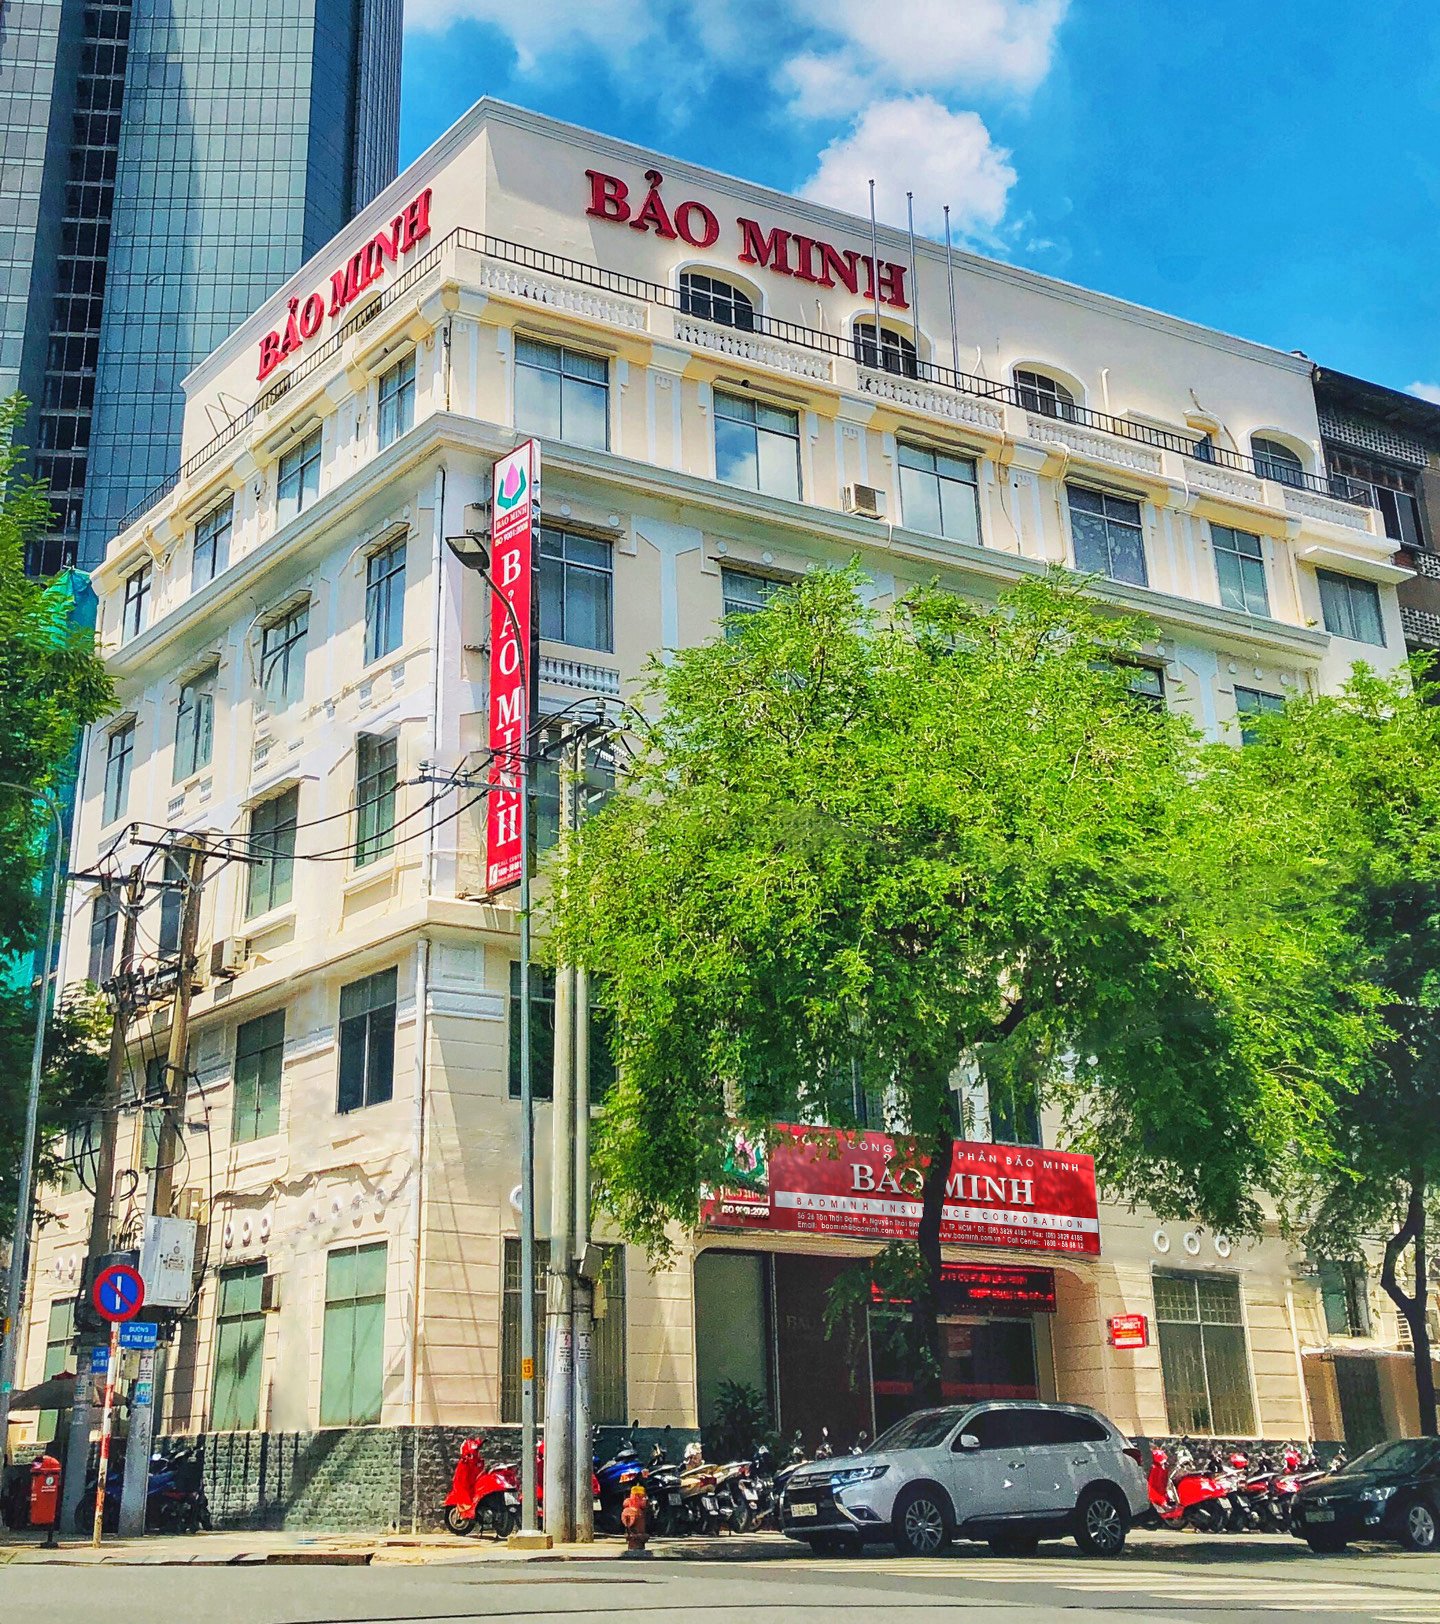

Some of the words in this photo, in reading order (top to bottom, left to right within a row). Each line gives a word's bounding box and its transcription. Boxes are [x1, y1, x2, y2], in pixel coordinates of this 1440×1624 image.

[584, 168, 720, 249] BẢO
[736, 216, 911, 310] MINH
[256, 295, 325, 381] BẢO
[328, 187, 433, 317] MINH
[496, 685, 522, 848] MINH
[847, 1141, 893, 1153] CÔNG
[958, 1150, 997, 1164] PHẦN
[1043, 1161, 1079, 1172] MINH
[944, 1173, 1035, 1206] MINH
[722, 1205, 734, 1213] ISO
[796, 1197, 869, 1211] BAOMINH
[881, 1201, 970, 1219] INSUNCE
[982, 1211, 1083, 1229] CORPORATION
[816, 1213, 828, 1221] Tôn
[797, 1221, 818, 1229] Email:
[1007, 1236, 1018, 1244] Call
